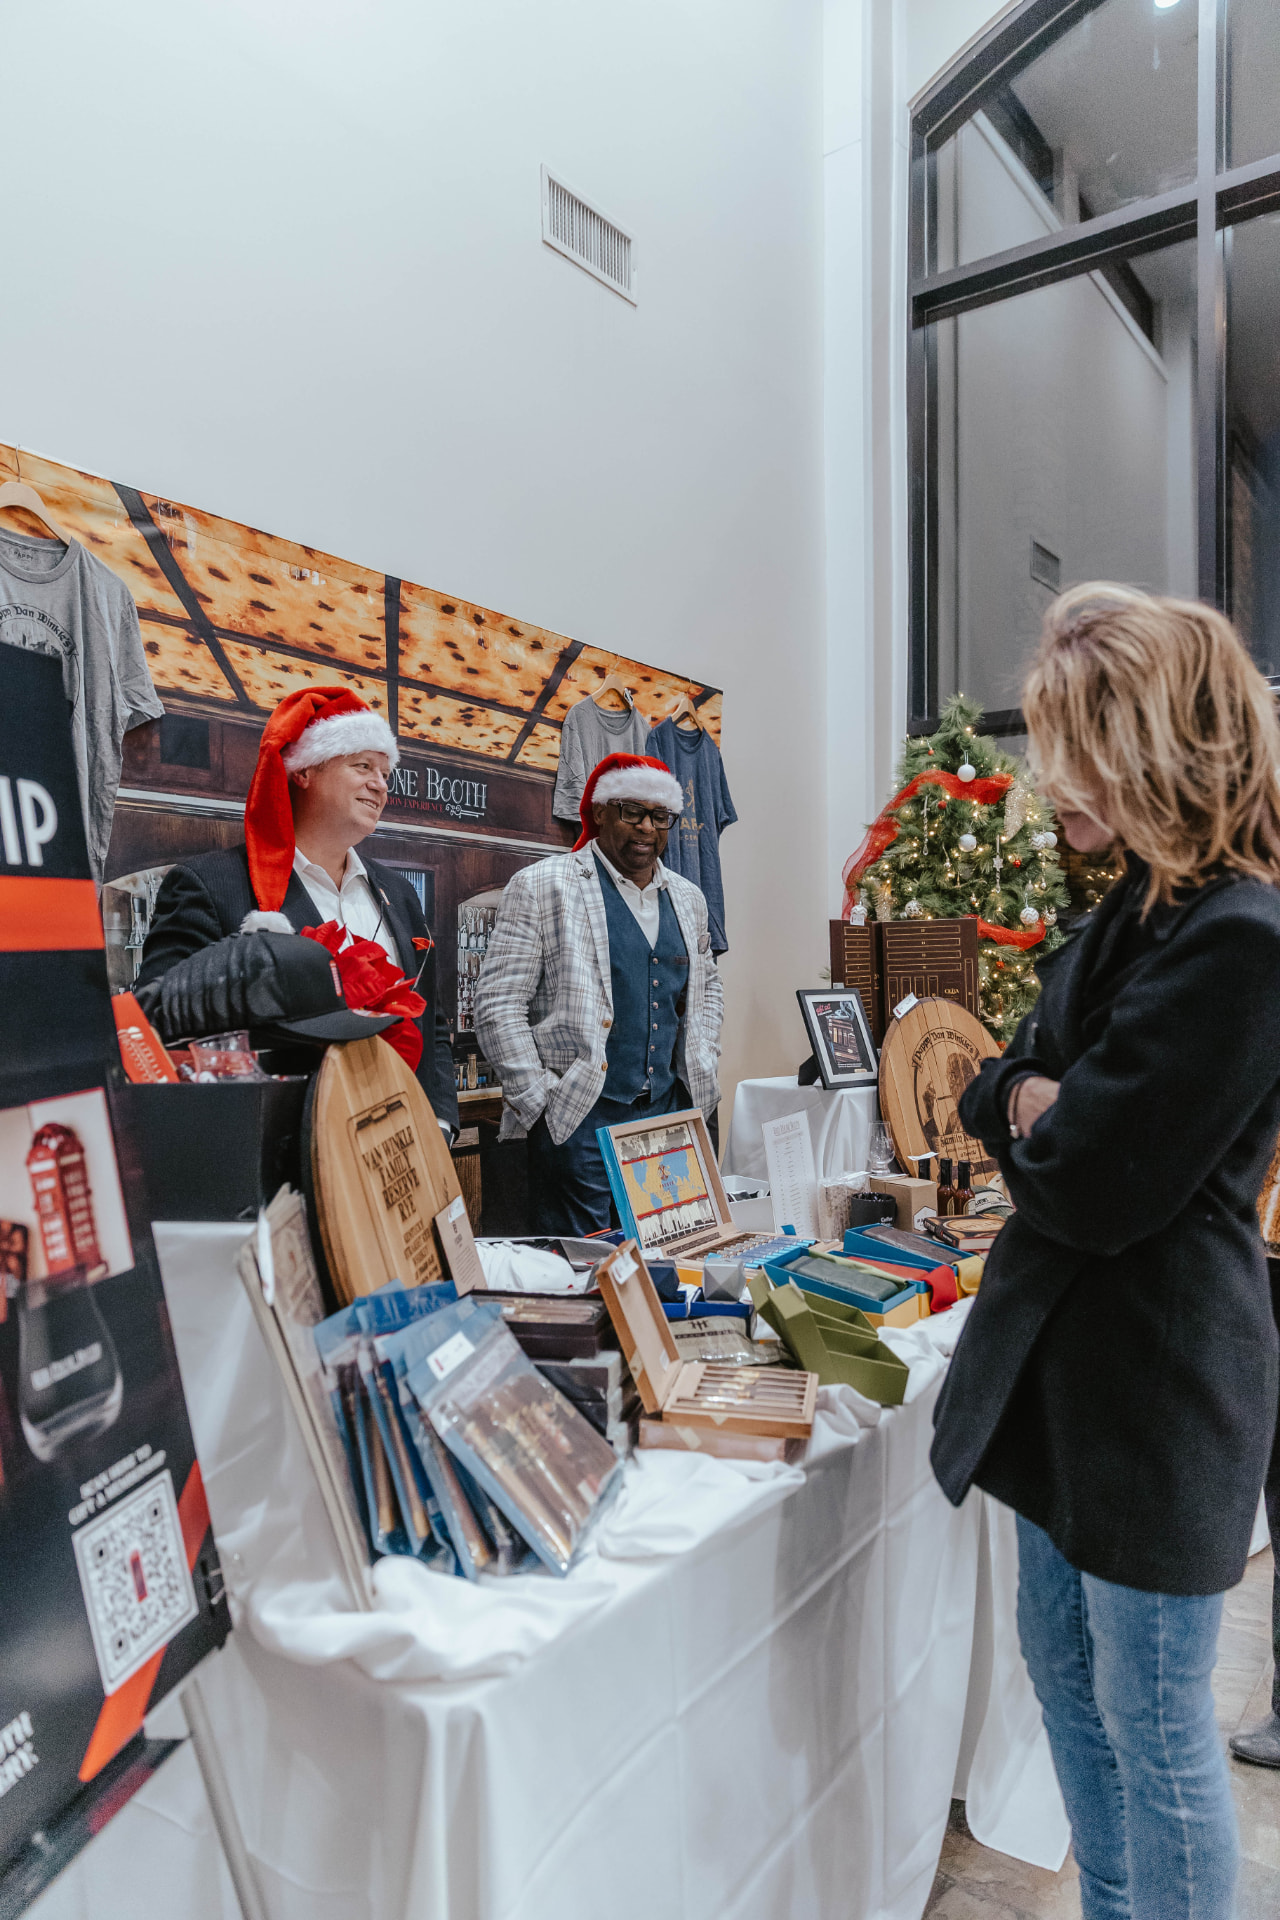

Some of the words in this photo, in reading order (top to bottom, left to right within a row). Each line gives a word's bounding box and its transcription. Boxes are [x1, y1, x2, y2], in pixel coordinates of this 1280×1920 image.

[13, 605, 34, 618] Van
[37, 610, 71, 648] Winkle's
[404, 798, 443, 812] EXPERIENCE
[426, 768, 487, 809] BOOTH
[914, 1037, 931, 1061] Pappy
[931, 1031, 945, 1041] Van
[945, 1030, 974, 1053] Winkle's
[362, 1146, 383, 1170] VAN
[381, 1125, 415, 1157] WINKLE
[378, 1151, 413, 1187] FAMILY
[382, 1167, 420, 1210] RESERVE
[398, 1194, 417, 1223] RYE
